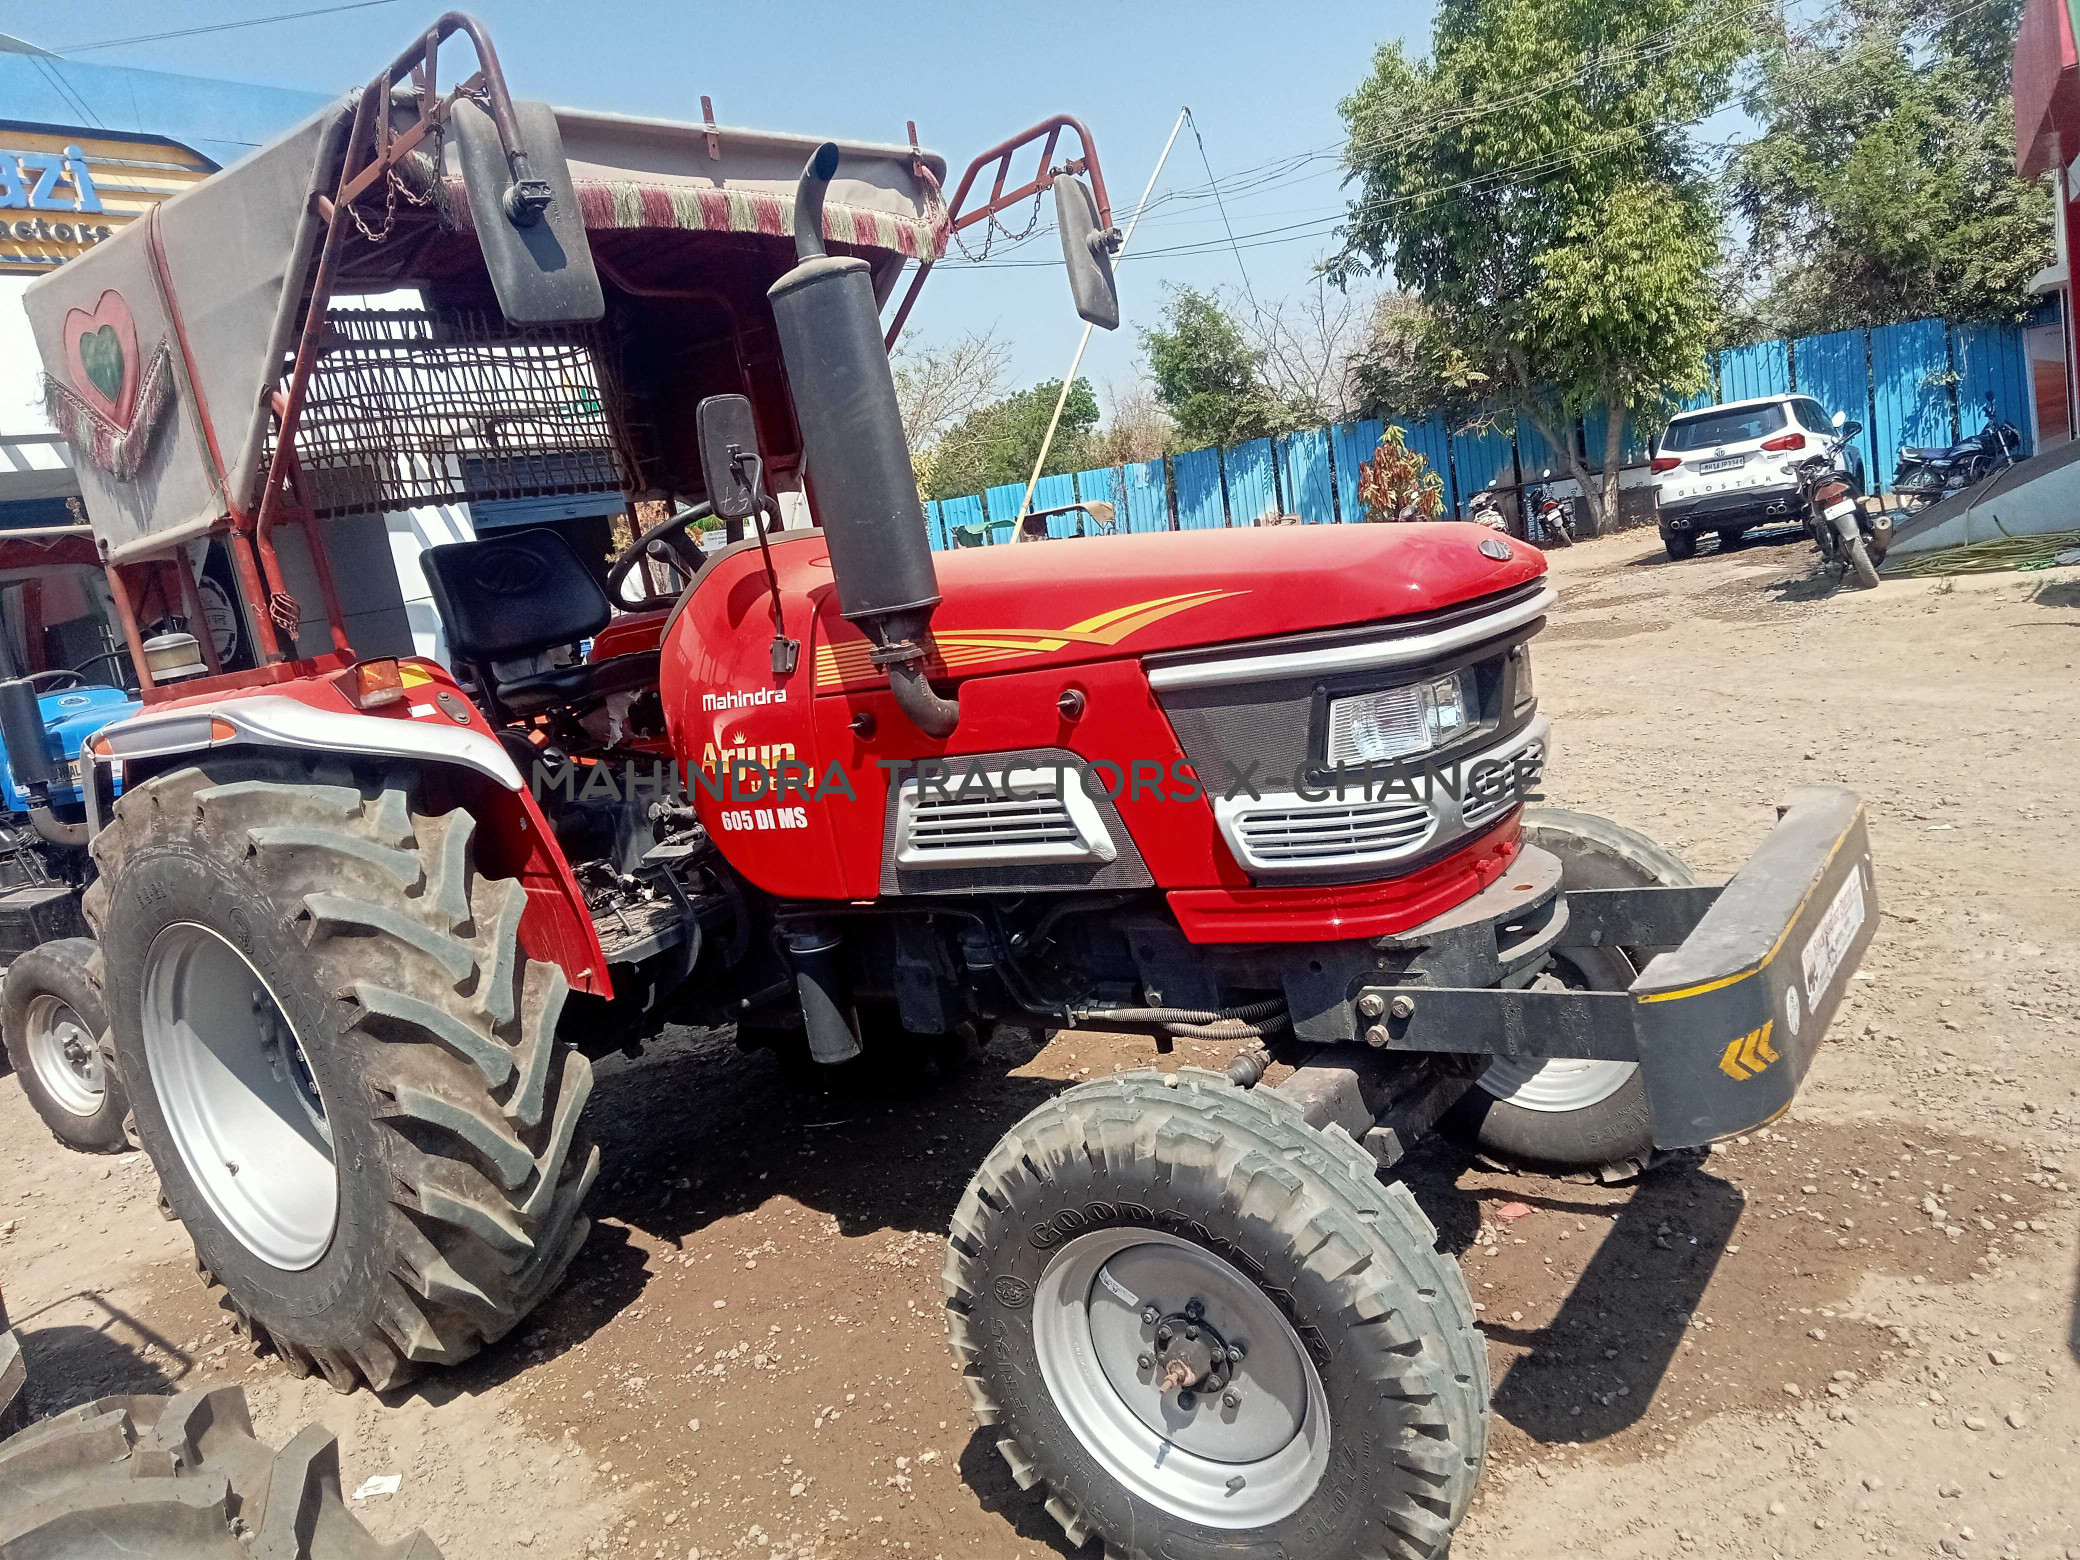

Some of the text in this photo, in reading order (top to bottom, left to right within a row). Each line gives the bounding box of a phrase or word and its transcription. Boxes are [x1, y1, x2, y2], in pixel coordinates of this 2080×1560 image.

[1678, 475, 1772, 497] GLOSTER
[702, 687, 787, 712] Mahindra
[701, 732, 796, 782] Arjun
[721, 806, 809, 832] 605 DI MS
